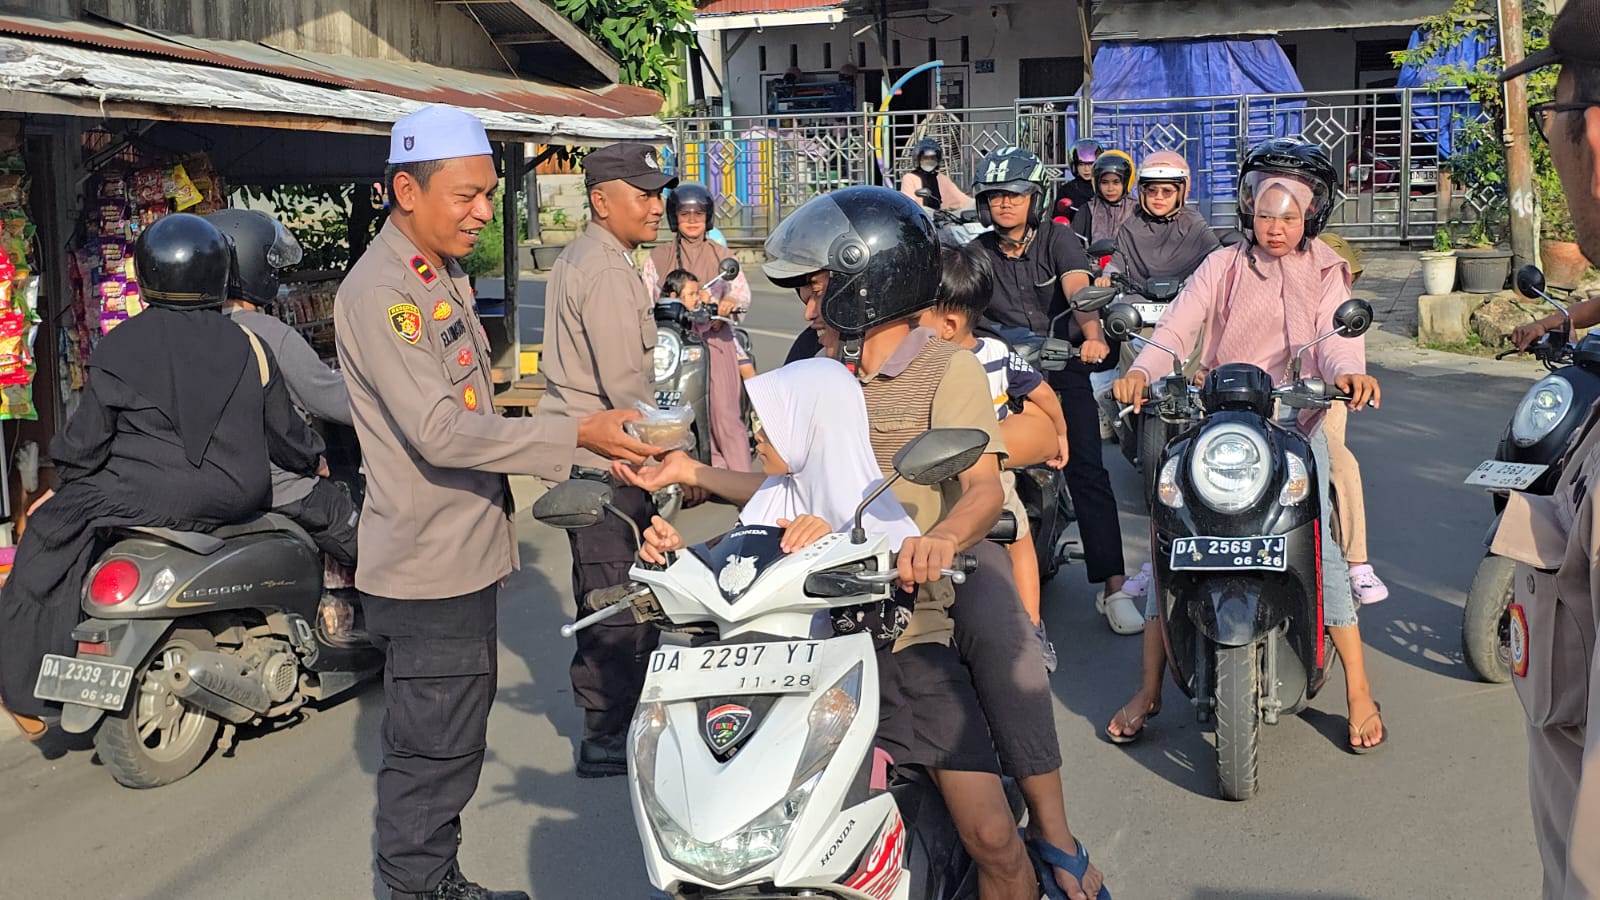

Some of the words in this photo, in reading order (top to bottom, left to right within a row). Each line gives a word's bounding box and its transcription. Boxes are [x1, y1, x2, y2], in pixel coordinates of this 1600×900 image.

[730, 529, 769, 539] HONDA
[1176, 540, 1197, 554] DA
[1208, 540, 1252, 554] 2569
[1262, 538, 1284, 553] YJ
[651, 651, 679, 673] DA
[700, 644, 766, 670] 2297
[786, 642, 819, 666] YT
[43, 658, 60, 677] DA
[65, 663, 102, 683] 2339
[110, 668, 130, 688] YJ
[820, 819, 856, 867] HONDA
